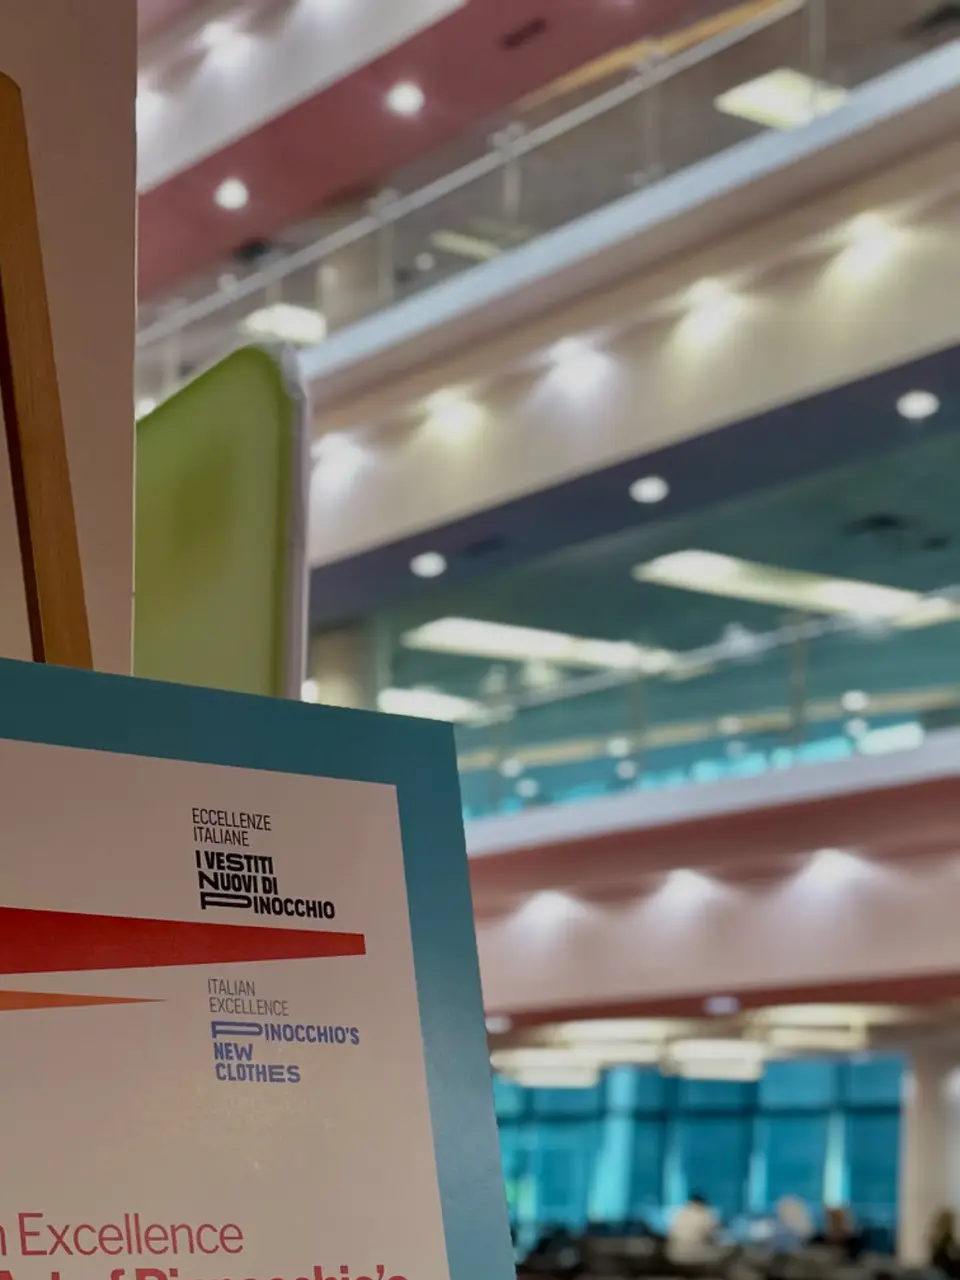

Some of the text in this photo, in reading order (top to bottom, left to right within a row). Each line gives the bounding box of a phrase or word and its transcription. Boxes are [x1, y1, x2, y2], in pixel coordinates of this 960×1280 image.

[192, 807, 272, 831] ECCELLENZE
[193, 826, 249, 847] ITALIANE
[195, 850, 274, 875] I VESTITI
[198, 871, 279, 895] NUOVI DI
[200, 891, 335, 919] PINOCCHIO
[208, 978, 256, 996] ITALIAN
[209, 997, 289, 1016] EXCELLENCE
[211, 1021, 360, 1045] PINOCCHIO'S
[213, 1042, 254, 1061] NEW
[215, 1063, 301, 1083] CLOTHES
[19, 1212, 244, 1257] Excellence
